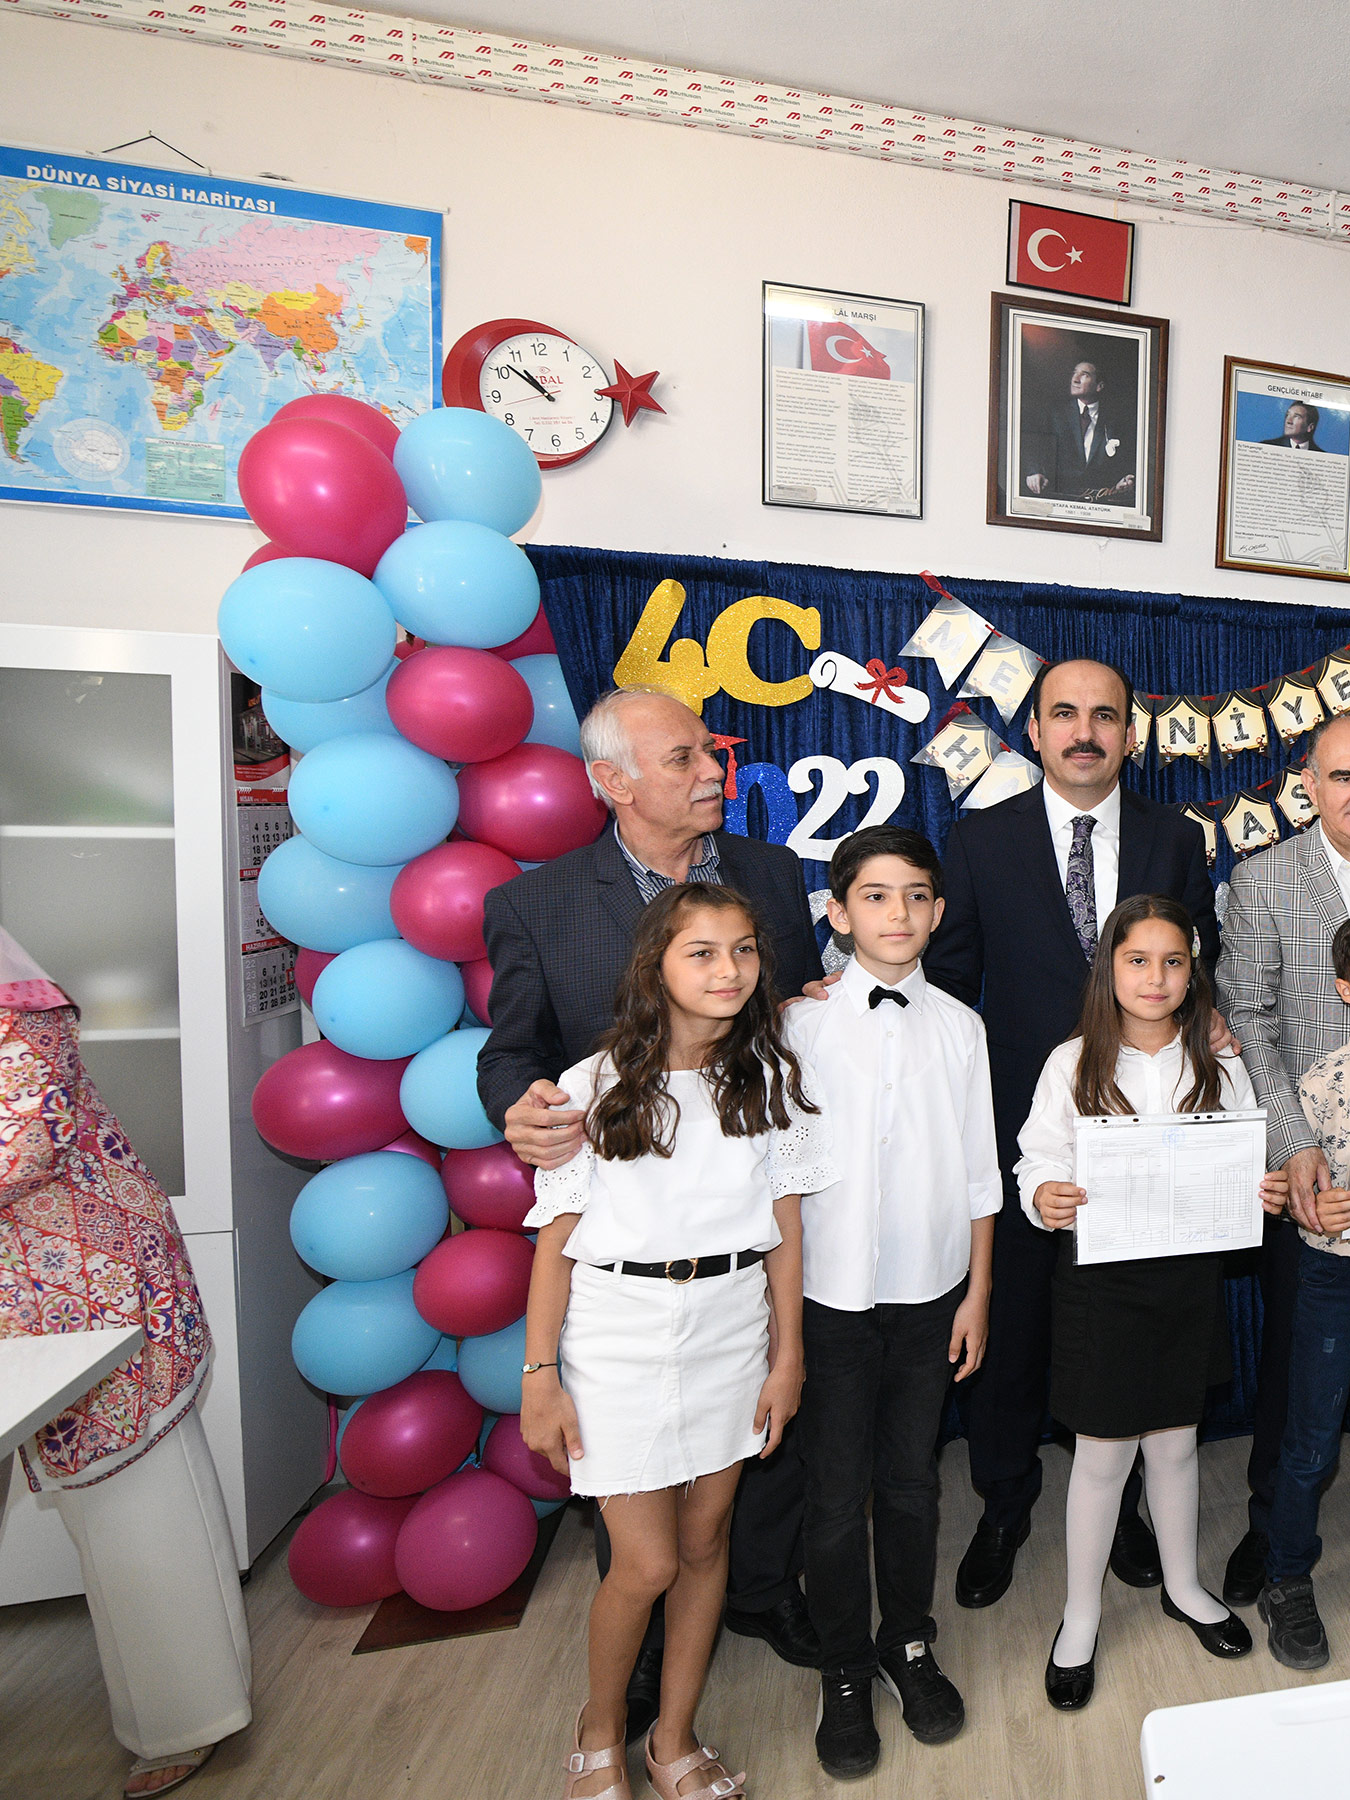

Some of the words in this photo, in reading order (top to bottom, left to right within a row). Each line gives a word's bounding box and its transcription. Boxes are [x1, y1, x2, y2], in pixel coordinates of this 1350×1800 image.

[27, 165, 100, 187] DÜNYA
[107, 176, 174, 199] SİYASİ
[181, 188, 276, 213] HARİTASI
[851, 311, 877, 322] MARŞI
[531, 342, 548, 356] 12
[509, 350, 523, 363] 11
[562, 350, 570, 362] 1
[495, 366, 510, 380] 10
[582, 365, 592, 379] 2
[491, 390, 502, 403] 9
[505, 413, 515, 426] 8
[590, 412, 600, 424] 4
[524, 429, 534, 441] 7
[575, 427, 585, 440] 5
[551, 435, 561, 447] 6
[613, 578, 821, 716] 4C
[254, 823, 259, 831] 4
[264, 822, 270, 831] 5
[274, 822, 279, 831] 6
[284, 822, 288, 830] 7
[252, 834, 259, 843] 11
[262, 834, 270, 842] 12
[272, 833, 280, 841] 13
[253, 845, 261, 854] 18
[263, 845, 271, 853] 19
[252, 857, 261, 865] 25
[256, 918, 264, 927] 16
[262, 968, 267, 976] 6
[272, 966, 276, 974] 7
[259, 979, 267, 988] 13
[270, 976, 277, 985] 14
[259, 990, 268, 1000] 20
[270, 988, 277, 997] 21
[260, 1001, 268, 1011] 27
[270, 998, 278, 1008] 28
